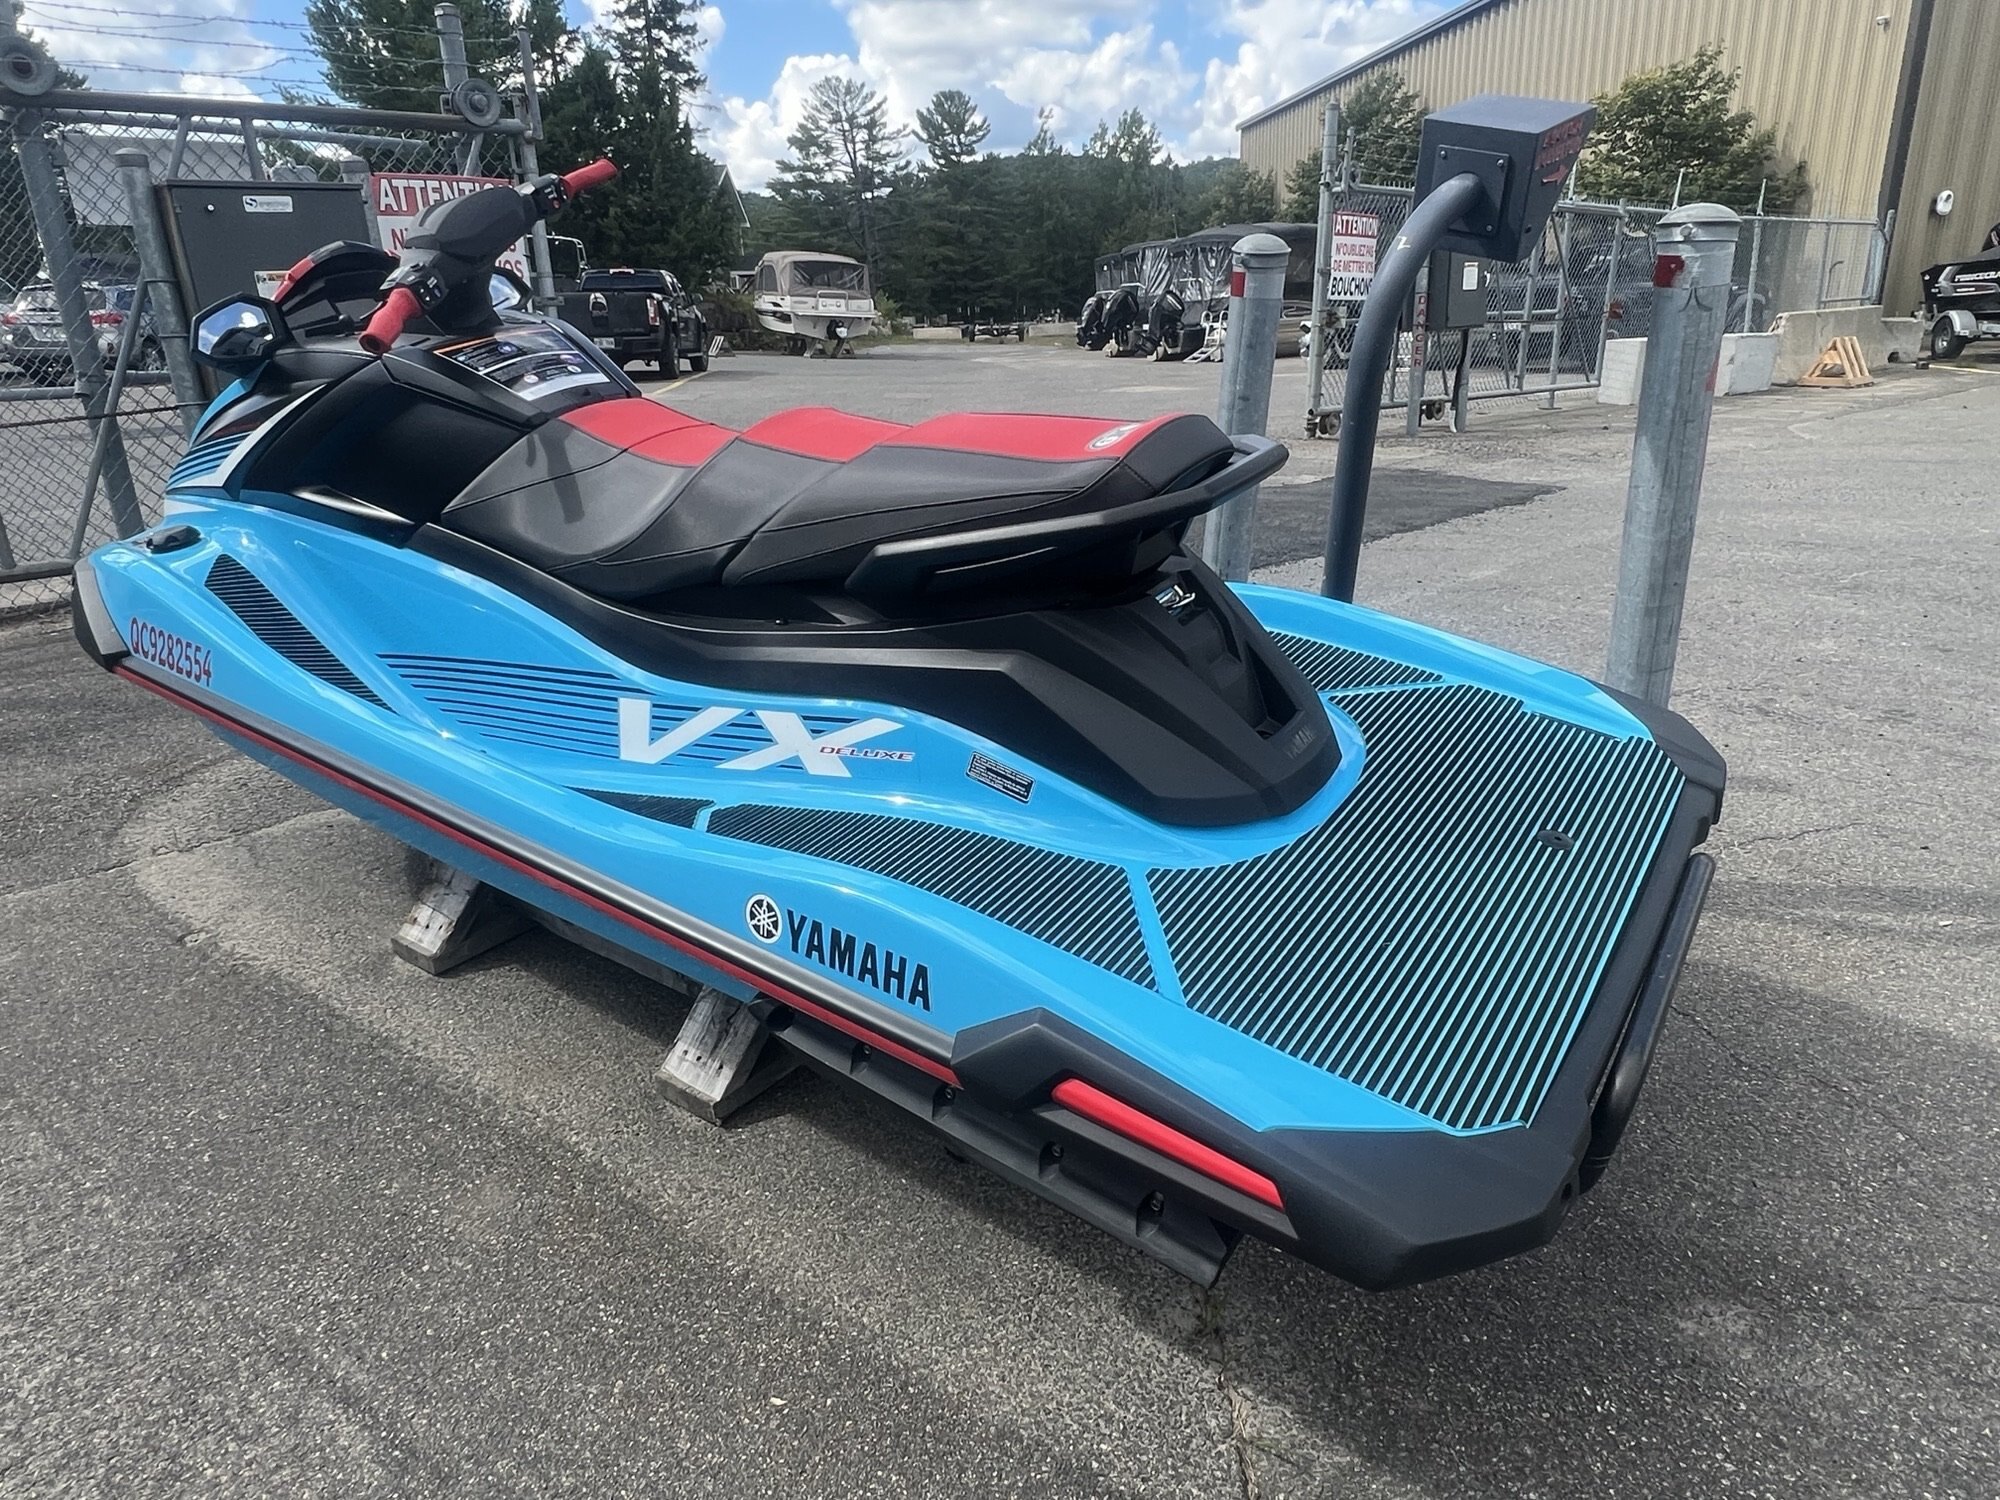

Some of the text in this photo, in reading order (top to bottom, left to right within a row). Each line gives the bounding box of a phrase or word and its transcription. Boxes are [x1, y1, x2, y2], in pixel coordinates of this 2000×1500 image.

[1335, 214, 1377, 237] ATTENTION
[1333, 259, 1342, 272] DE
[1342, 260, 1365, 273] METTRE
[1413, 295, 1427, 368] DANGER
[130, 616, 212, 687] QC9282554
[618, 697, 905, 778] VX
[819, 745, 915, 762] DELUXE
[786, 908, 932, 1013] YAMAHA
